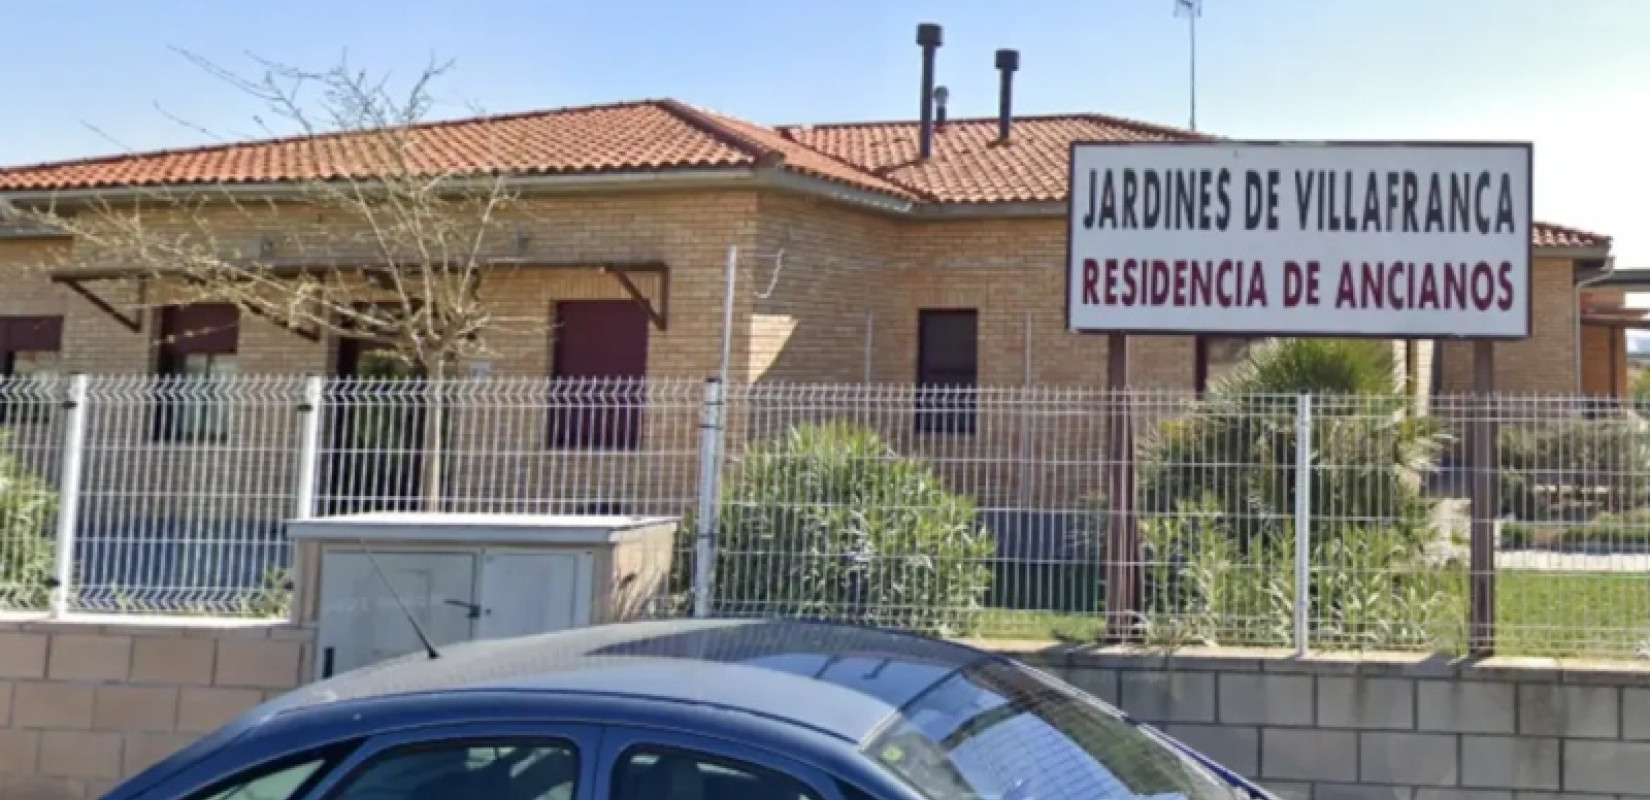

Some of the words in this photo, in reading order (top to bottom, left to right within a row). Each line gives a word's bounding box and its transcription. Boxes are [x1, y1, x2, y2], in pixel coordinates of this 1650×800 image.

[1083, 168, 1231, 232] JARDINES
[1244, 170, 1281, 230] DE
[1295, 170, 1514, 234] VILLAFRANCA
[1082, 258, 1268, 308] RESIDENCIA
[1283, 261, 1320, 308] DE
[1335, 261, 1514, 312] ANCIANOS
